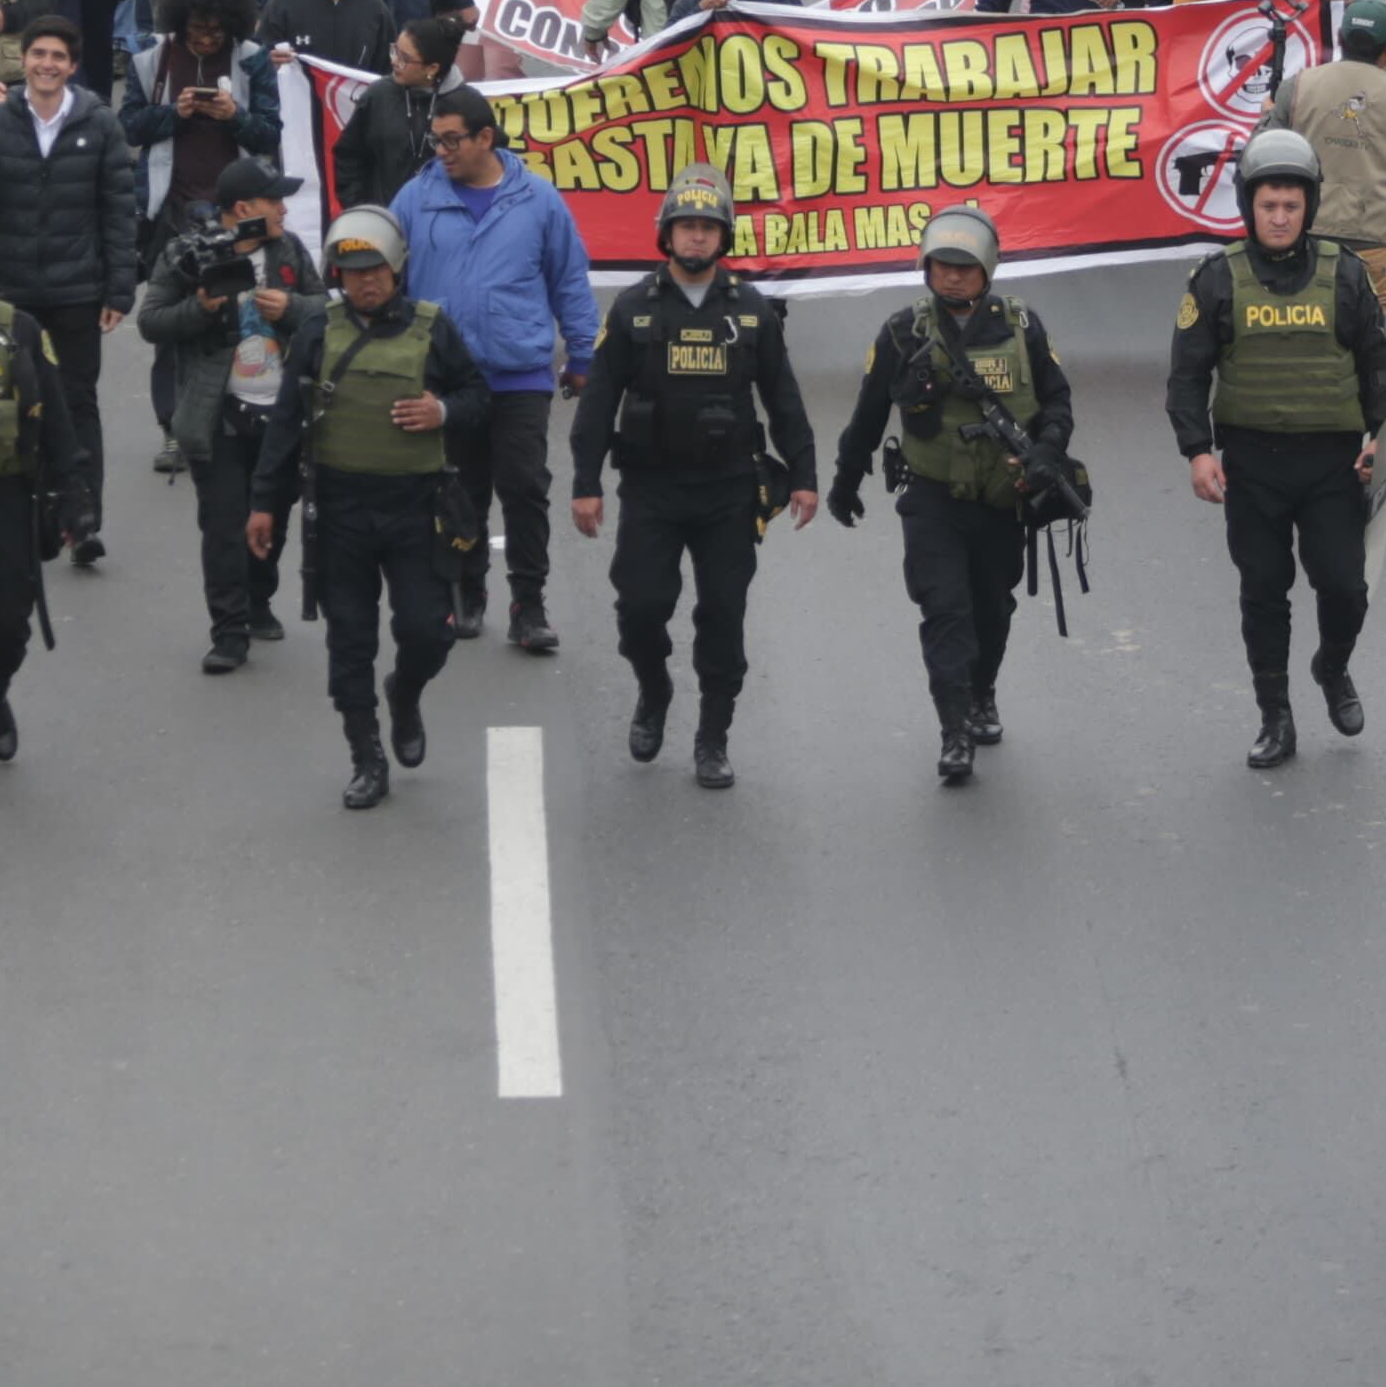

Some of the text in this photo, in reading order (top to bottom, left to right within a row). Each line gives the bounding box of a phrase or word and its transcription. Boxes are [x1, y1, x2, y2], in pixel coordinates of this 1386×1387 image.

[812, 18, 1158, 110] TRABAJAR
[707, 121, 782, 206] YA
[793, 112, 869, 201] DE
[877, 105, 1145, 196] MUERTE
[676, 186, 719, 207] POLICIA
[764, 208, 850, 257] BALA
[853, 201, 932, 251] MAS
[1246, 305, 1326, 328] POLICIA
[671, 345, 723, 369] POLICIA
